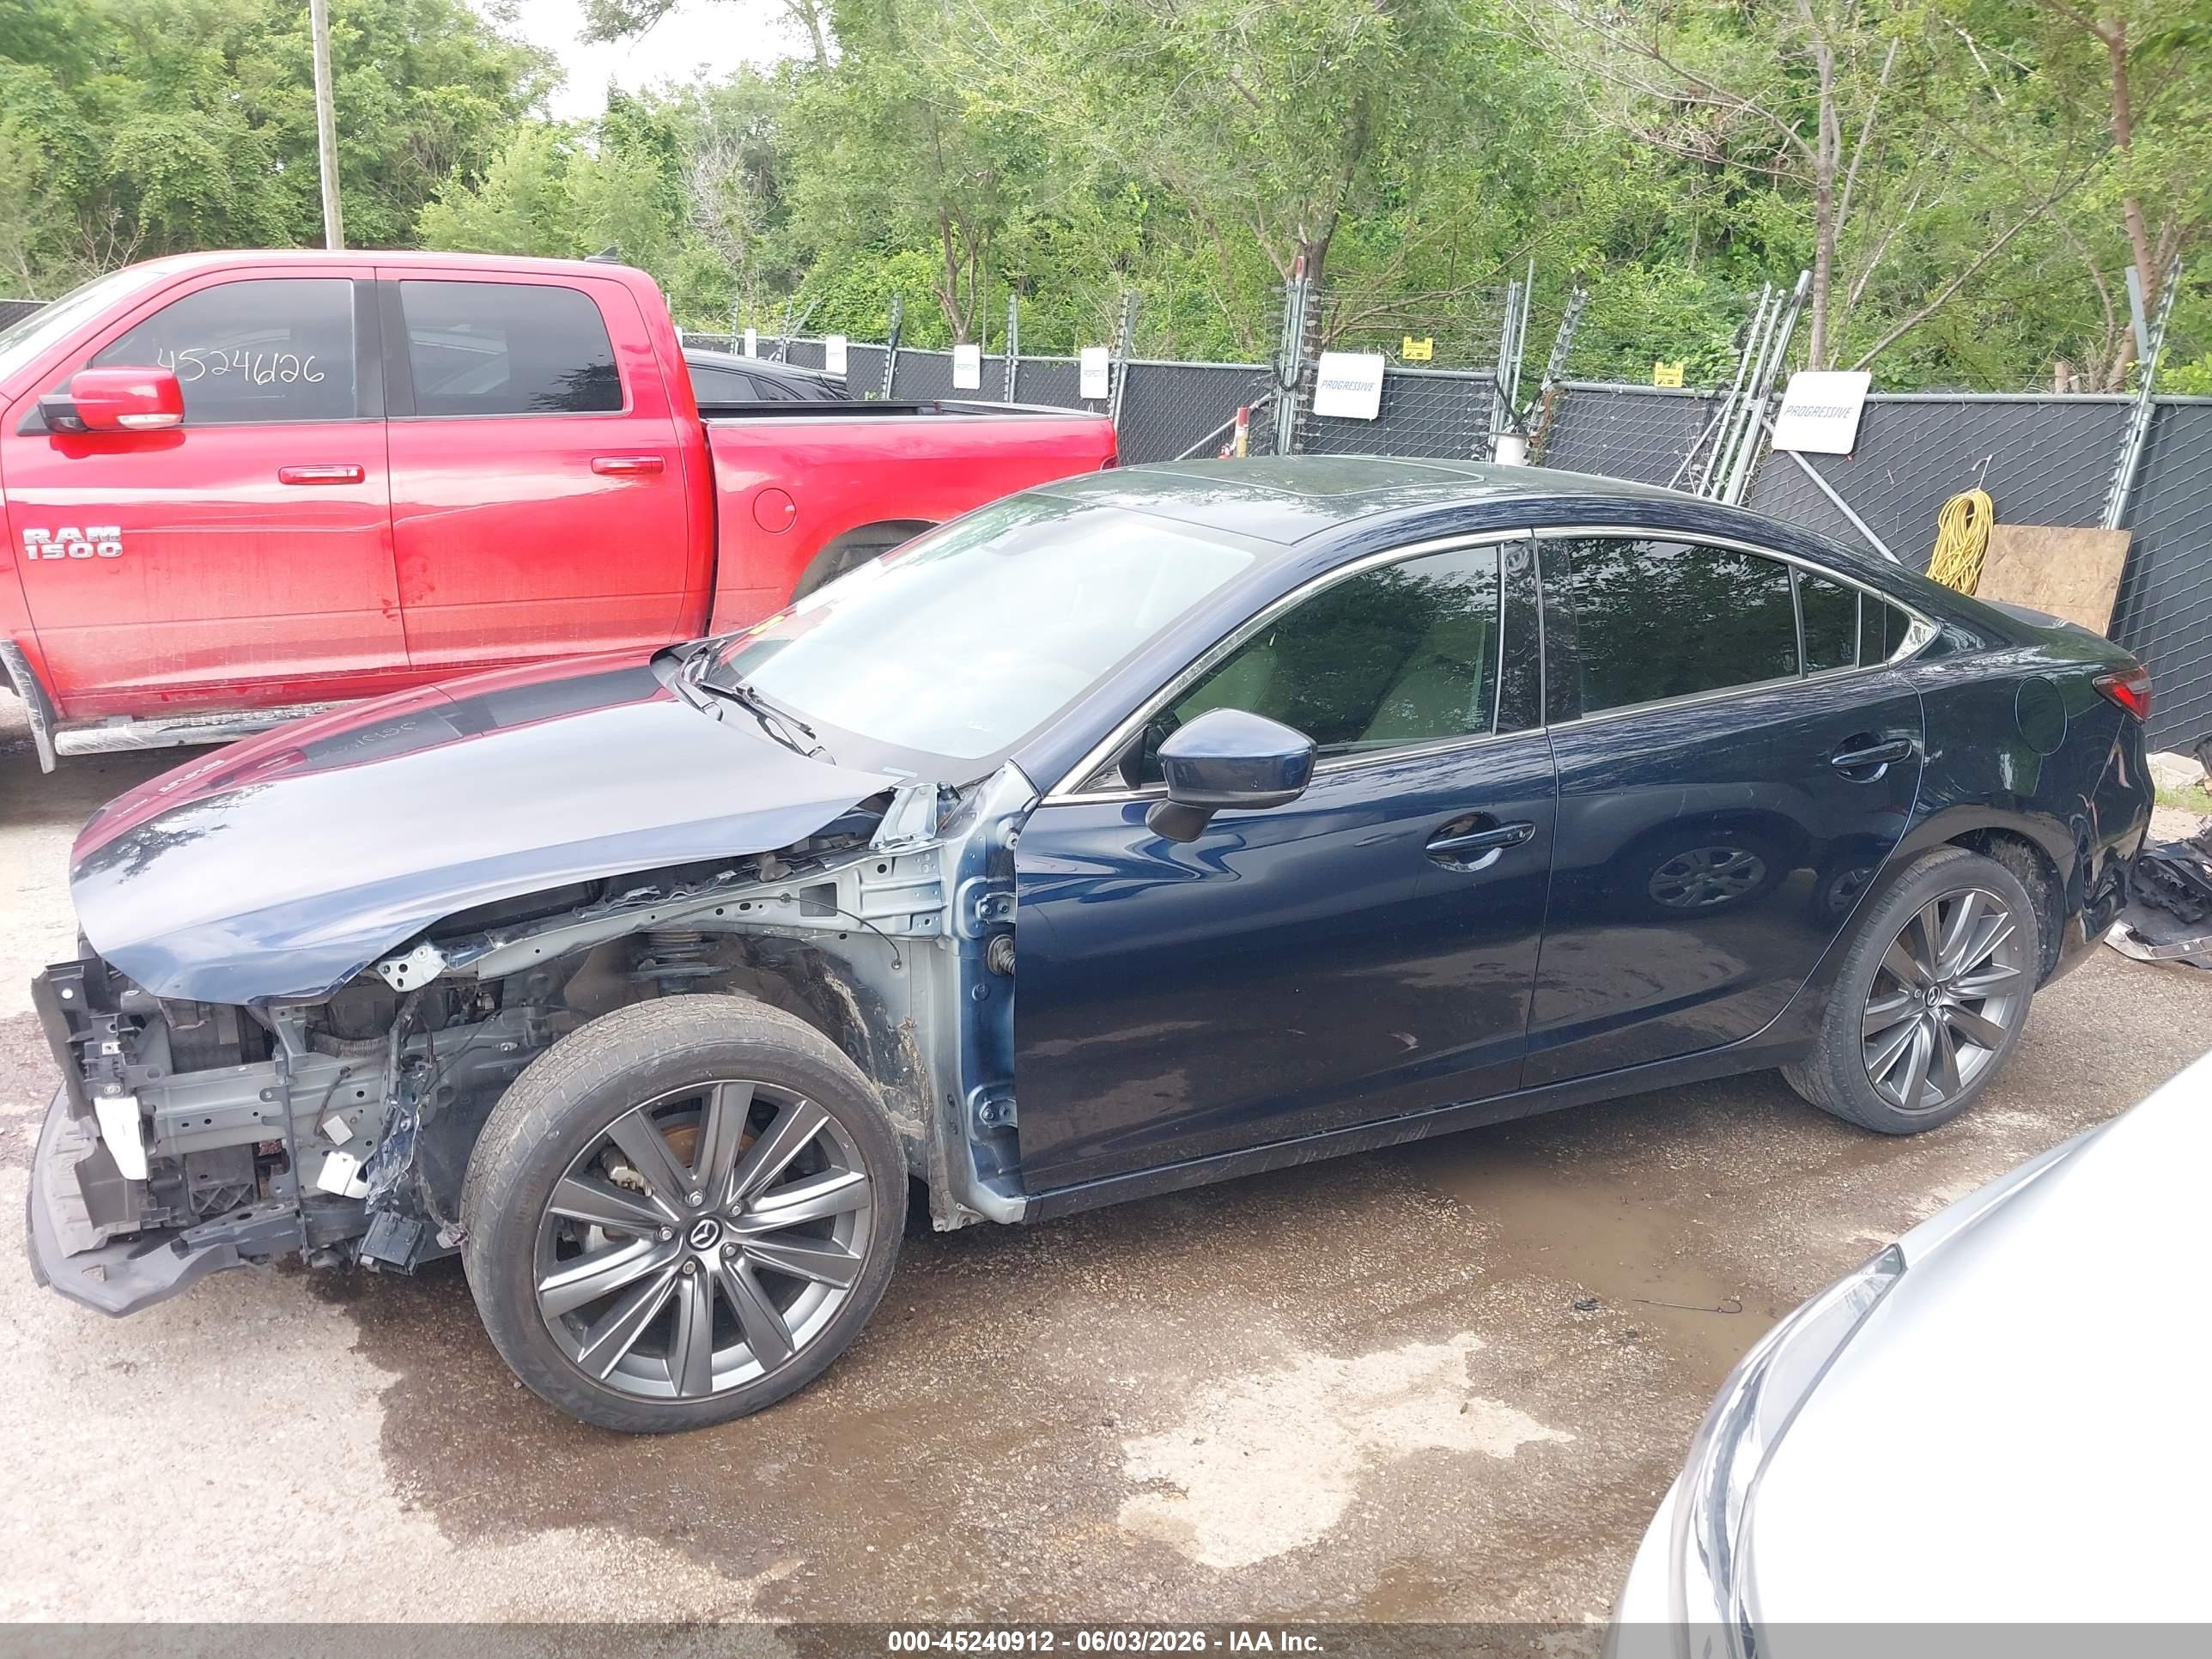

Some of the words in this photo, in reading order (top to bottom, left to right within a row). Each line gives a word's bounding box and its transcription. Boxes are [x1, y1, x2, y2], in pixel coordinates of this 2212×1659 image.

[1320, 380, 1375, 392] PROGRESSIVE
[1784, 405, 1853, 418] PROGRESSIVE
[22, 526, 121, 544] RAM
[24, 542, 124, 560] 1500
